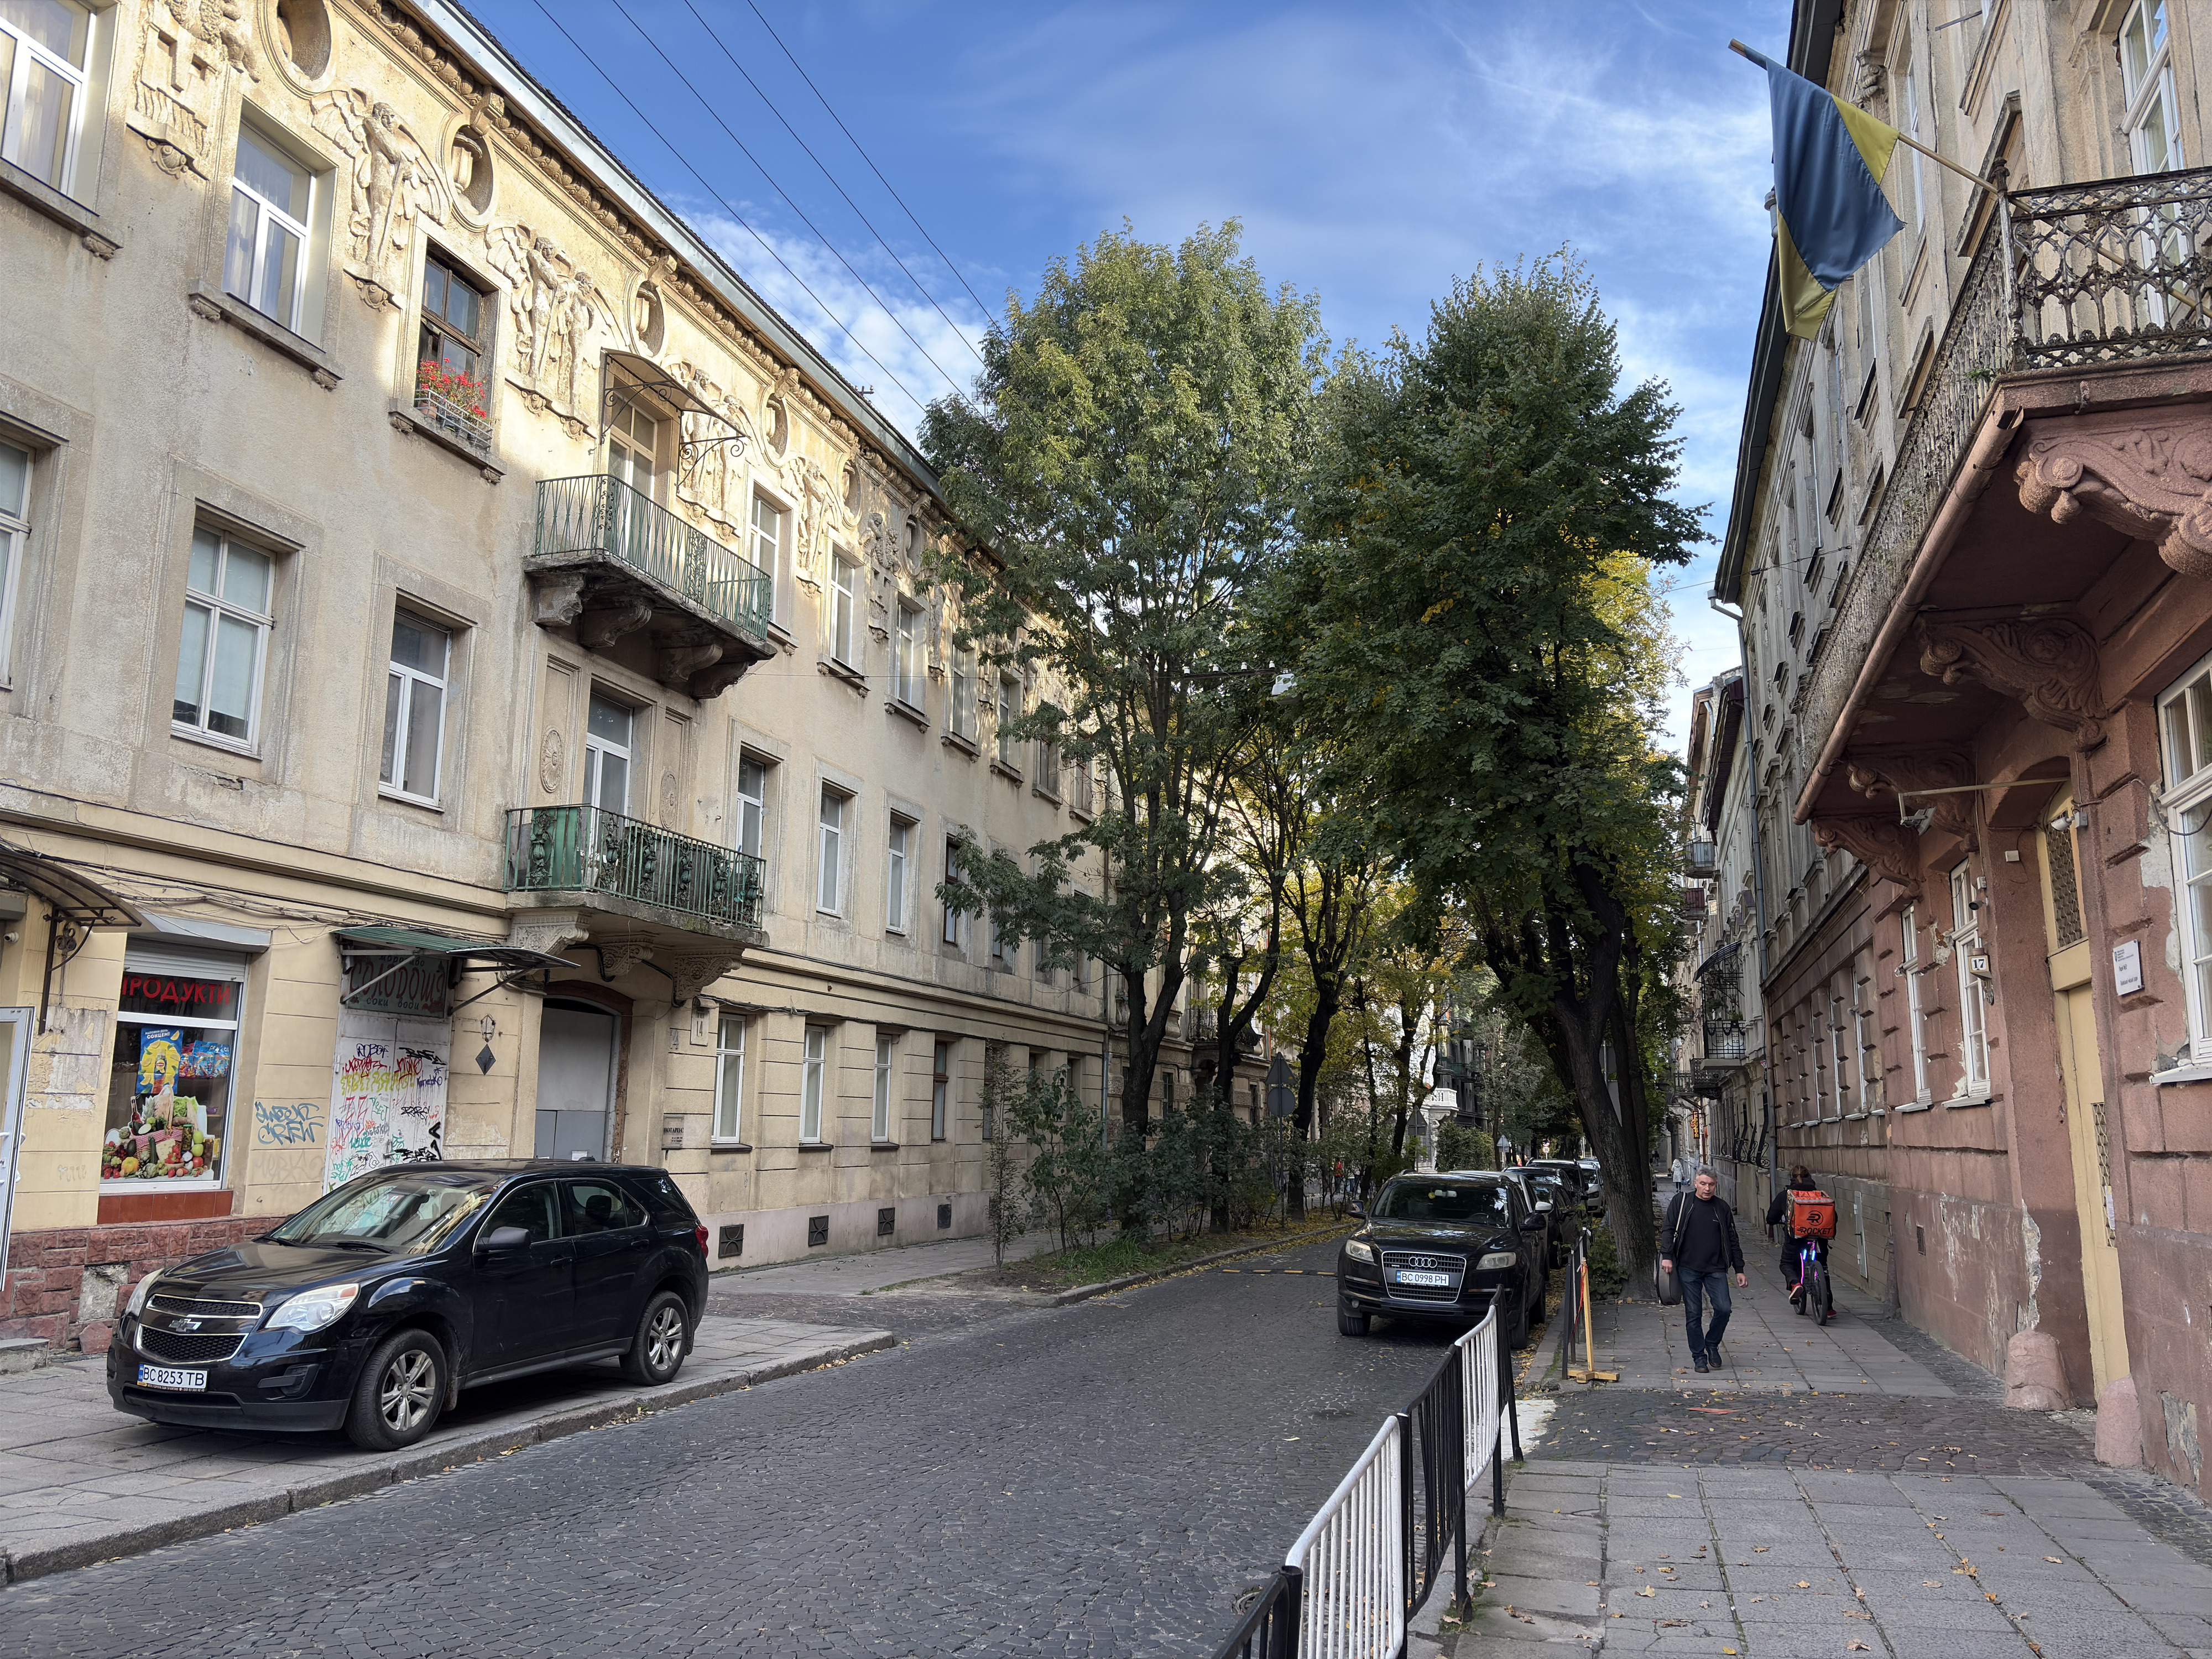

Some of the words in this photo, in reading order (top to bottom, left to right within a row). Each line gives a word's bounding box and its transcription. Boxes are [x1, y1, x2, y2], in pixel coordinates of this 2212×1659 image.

[379, 955, 425, 967] морово
[1973, 958, 1984, 968] 17
[366, 997, 388, 1006] соки
[398, 997, 419, 1010] води
[696, 1021, 703, 1036] 14
[258, 1120, 324, 1146] CREW
[1797, 1227, 1833, 1235] ROCKET
[1402, 1272, 1413, 1281] BC
[1415, 1274, 1433, 1283] 0998
[1434, 1275, 1447, 1284] PH
[143, 1367, 156, 1381] BC
[158, 1370, 184, 1385] 8253
[186, 1372, 205, 1386] TB
